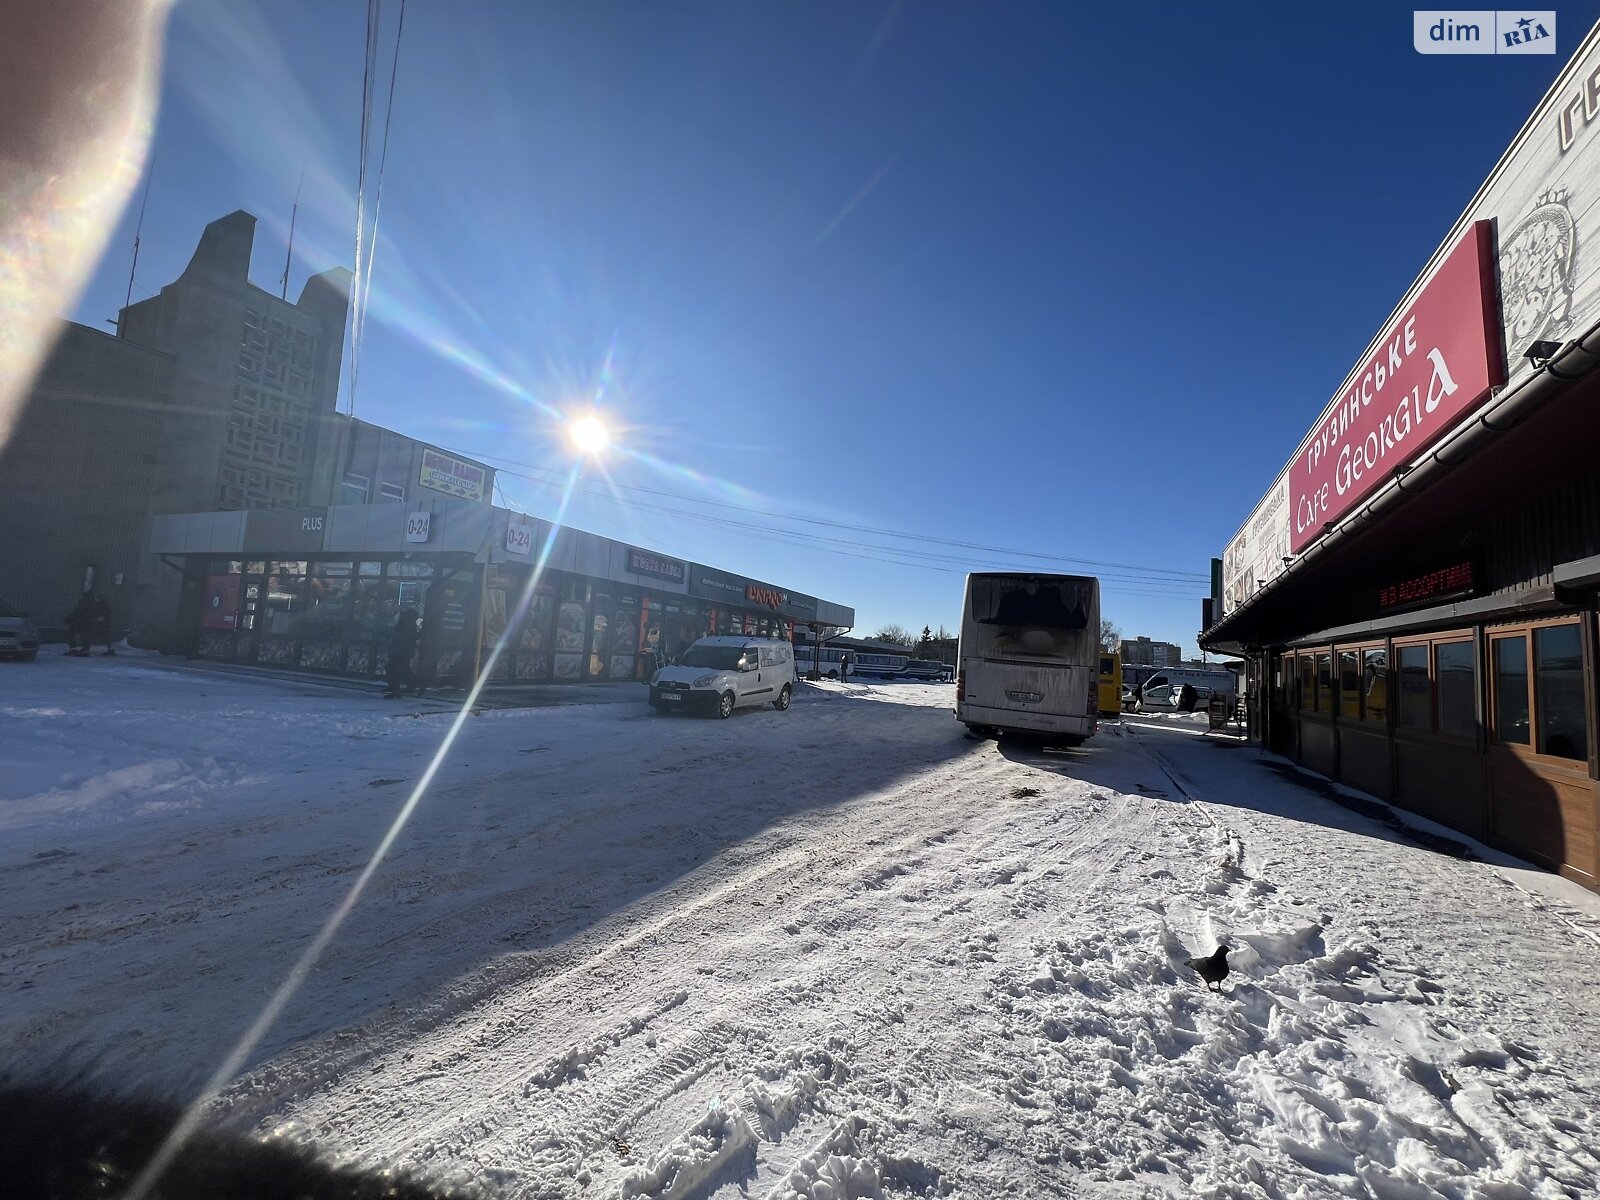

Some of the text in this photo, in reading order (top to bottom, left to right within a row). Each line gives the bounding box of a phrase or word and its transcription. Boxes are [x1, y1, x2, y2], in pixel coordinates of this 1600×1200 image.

[1308, 314, 1416, 474] ГРУЗИНСЬКЕ
[303, 517, 323, 530] PLUS
[408, 519, 428, 535] 0-24
[508, 529, 530, 547] 0-24
